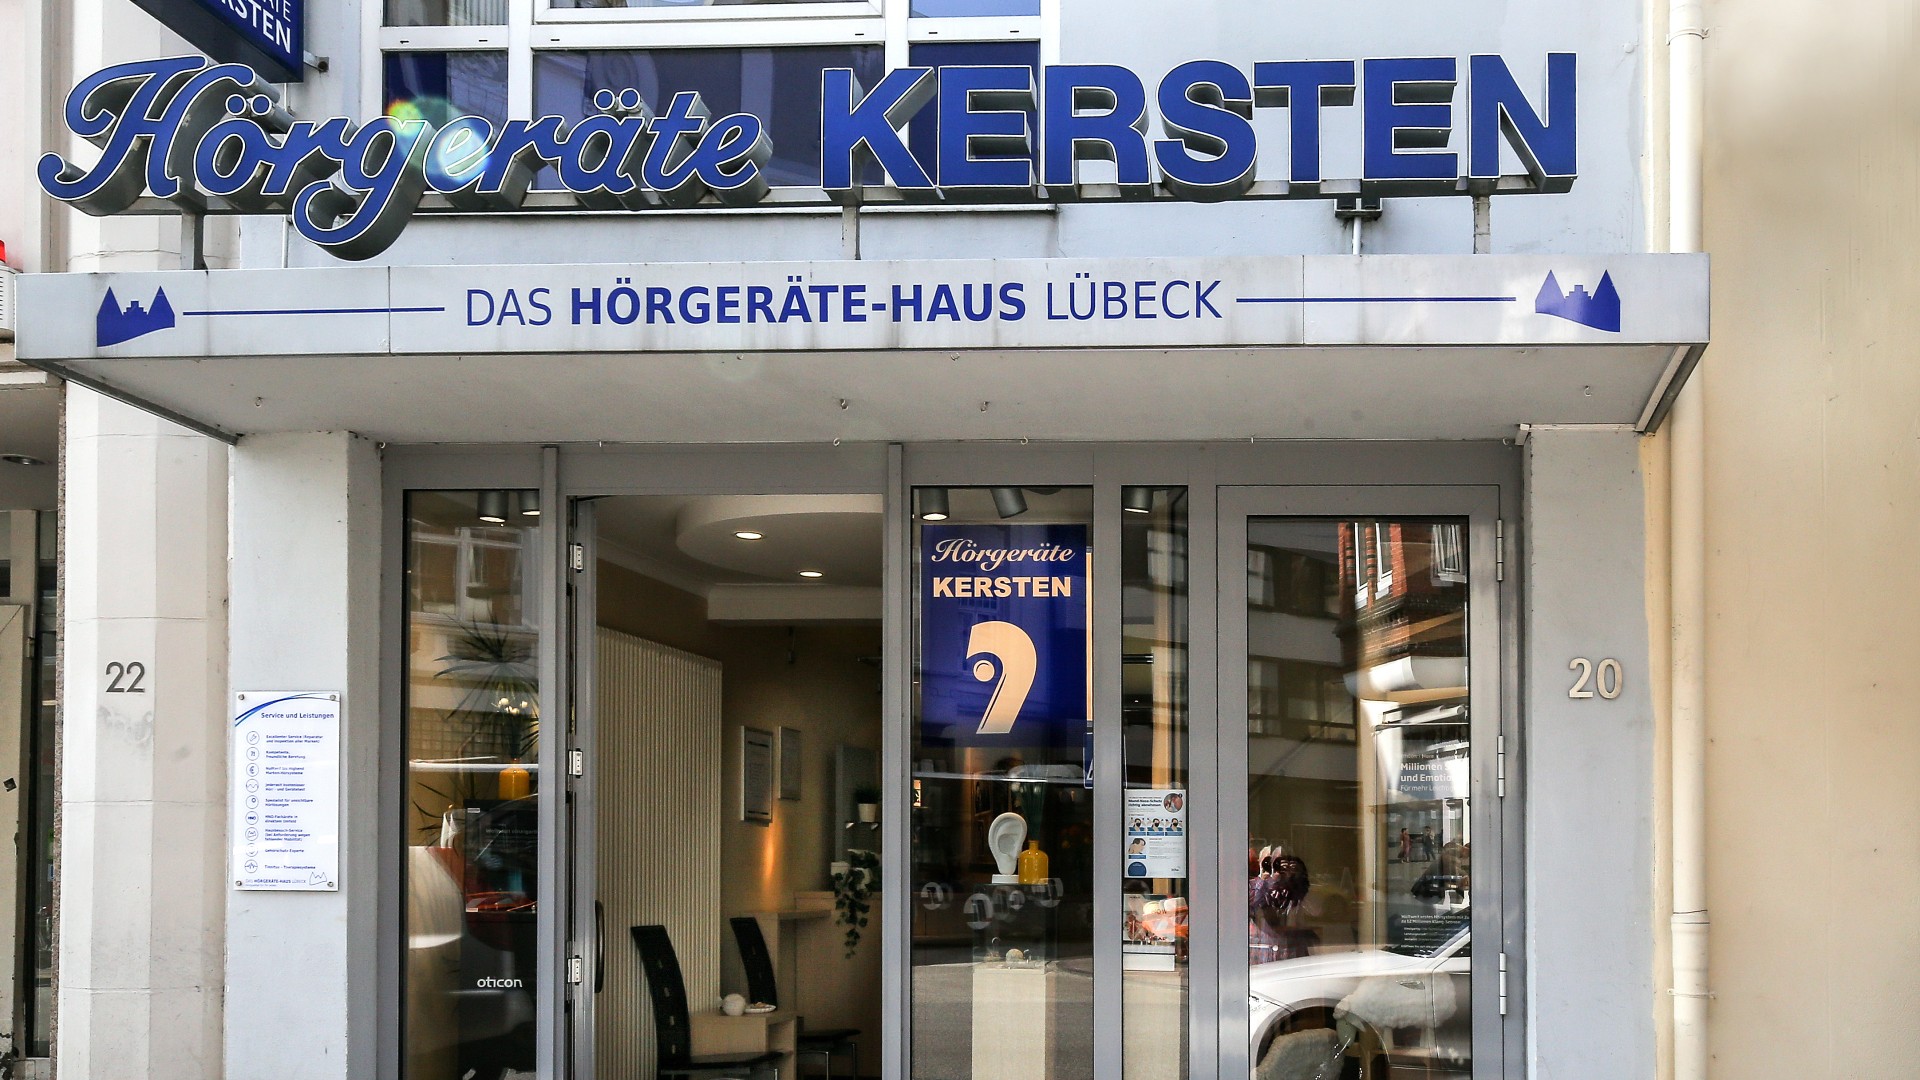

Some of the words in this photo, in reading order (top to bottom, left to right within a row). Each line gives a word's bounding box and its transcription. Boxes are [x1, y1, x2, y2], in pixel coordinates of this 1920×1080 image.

[37, 55, 764, 247] Hörgeräte
[821, 52, 1578, 191] KERSTEN
[466, 288, 552, 327] DAS
[571, 275, 1027, 326] HÖRGERÄTE-HAUS
[1047, 272, 1223, 320] LÜBECK
[931, 538, 1076, 572] Hörgeräte
[933, 577, 1072, 599] KERSTEN
[105, 661, 146, 693] 22
[1568, 657, 1624, 700] 20
[299, 712, 335, 720] Leistungen
[1400, 762, 1443, 771] Millionen
[1400, 773, 1418, 782] und
[1401, 784, 1411, 792] Für
[476, 976, 523, 988] oticon
